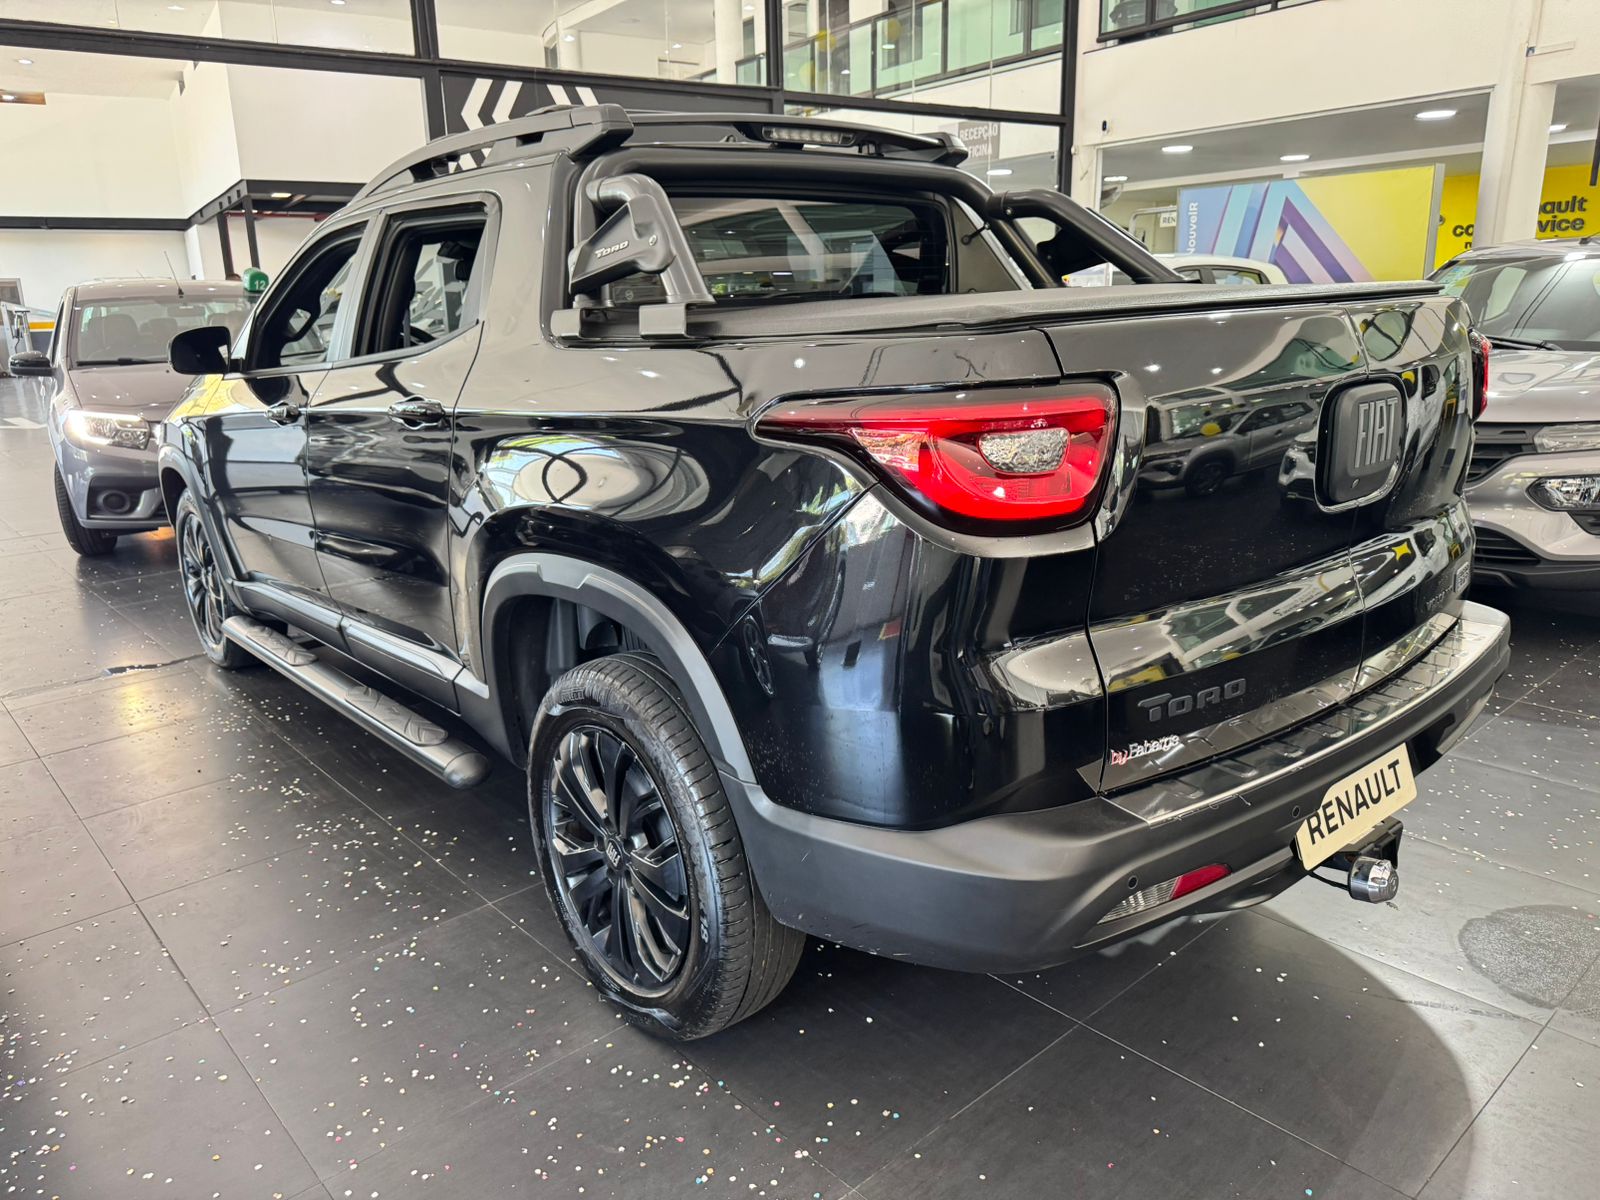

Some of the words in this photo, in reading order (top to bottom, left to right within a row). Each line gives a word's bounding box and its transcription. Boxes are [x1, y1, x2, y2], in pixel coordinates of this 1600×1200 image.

[968, 143, 993, 159] FICINA
[595, 240, 630, 259] TORO
[254, 280, 267, 291] 12
[1354, 396, 1398, 468] FIAT
[1137, 678, 1246, 722] TORO
[1305, 758, 1401, 846] RENAULT
